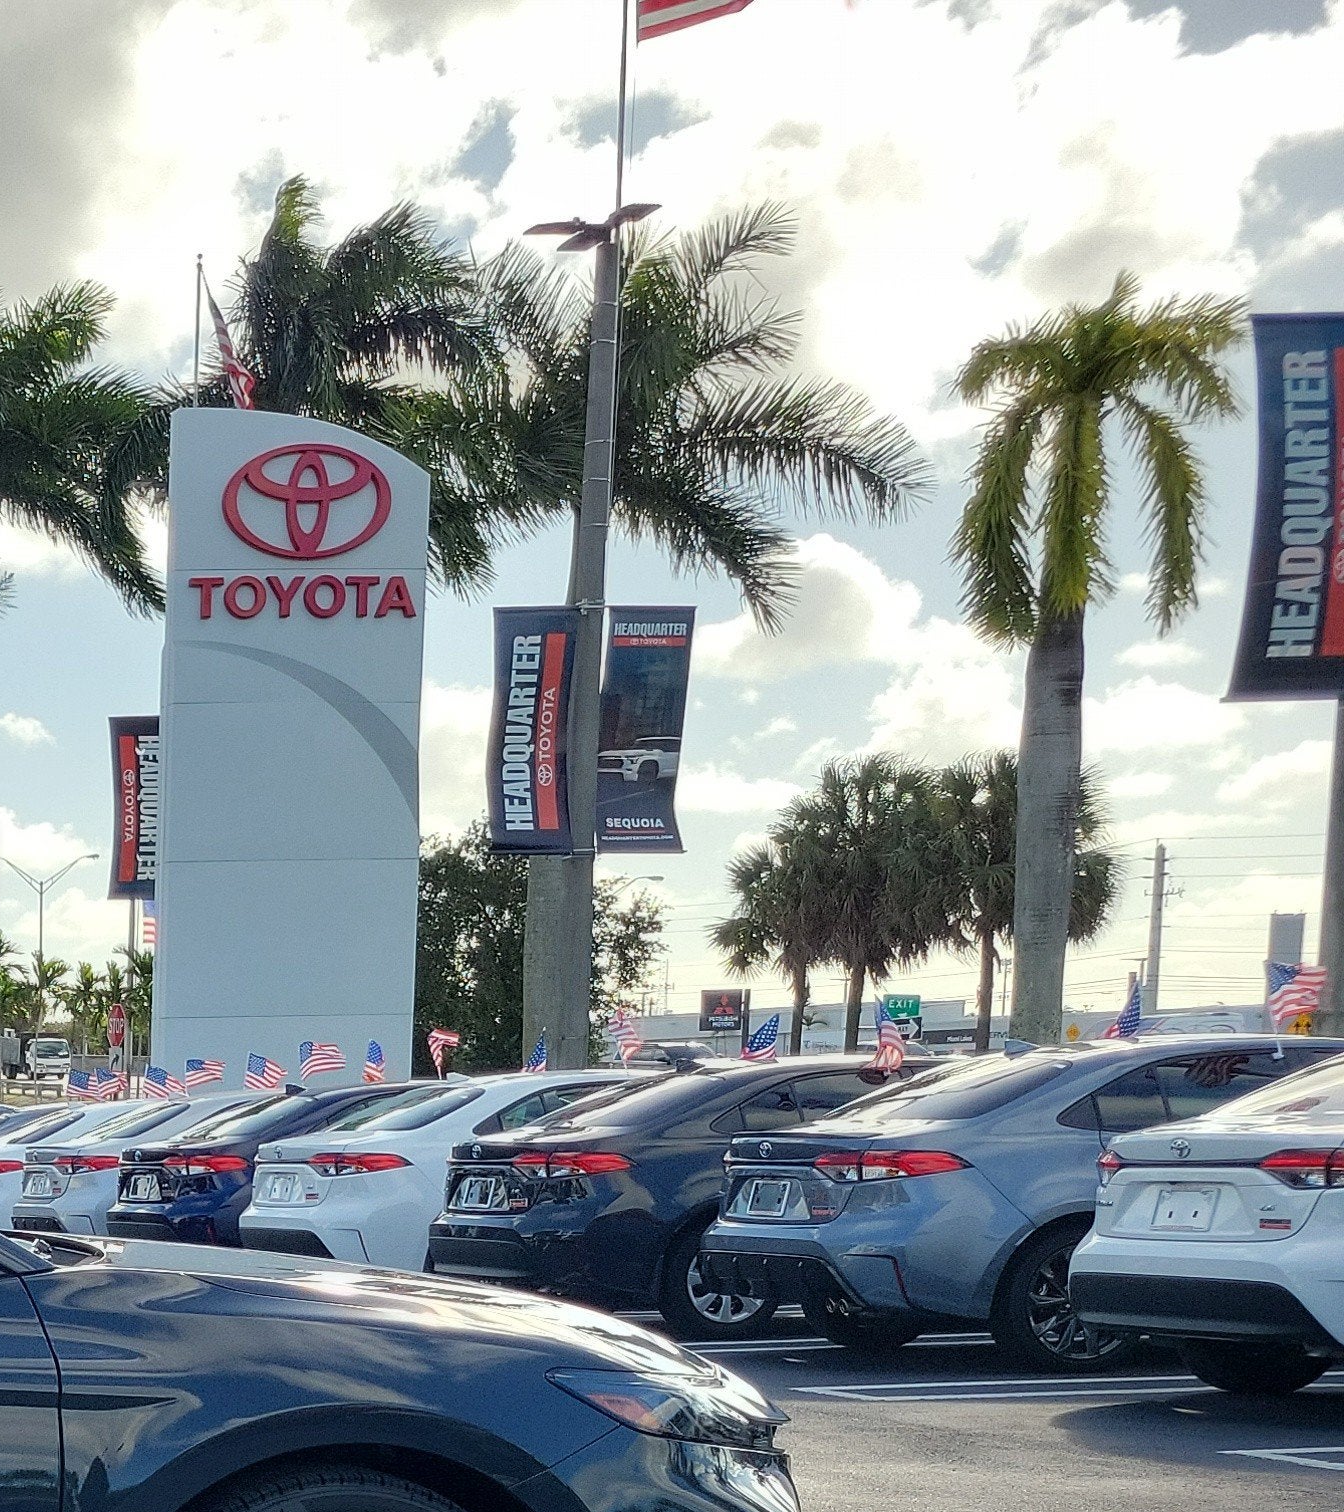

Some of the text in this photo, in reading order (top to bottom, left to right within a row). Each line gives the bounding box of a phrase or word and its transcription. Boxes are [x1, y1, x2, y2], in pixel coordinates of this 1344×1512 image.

[1265, 350, 1334, 658] HEADQUARTER
[188, 574, 417, 620] TOYOTA
[614, 622, 687, 638] HEADQUARTER
[502, 634, 542, 831] HEADQUARTER
[538, 687, 556, 762] TOYOTA
[124, 788, 134, 843] TOYOTA
[605, 817, 665, 829] SEQUOIA
[108, 1017, 124, 1034] STOP
[888, 999, 914, 1009] EXIT
